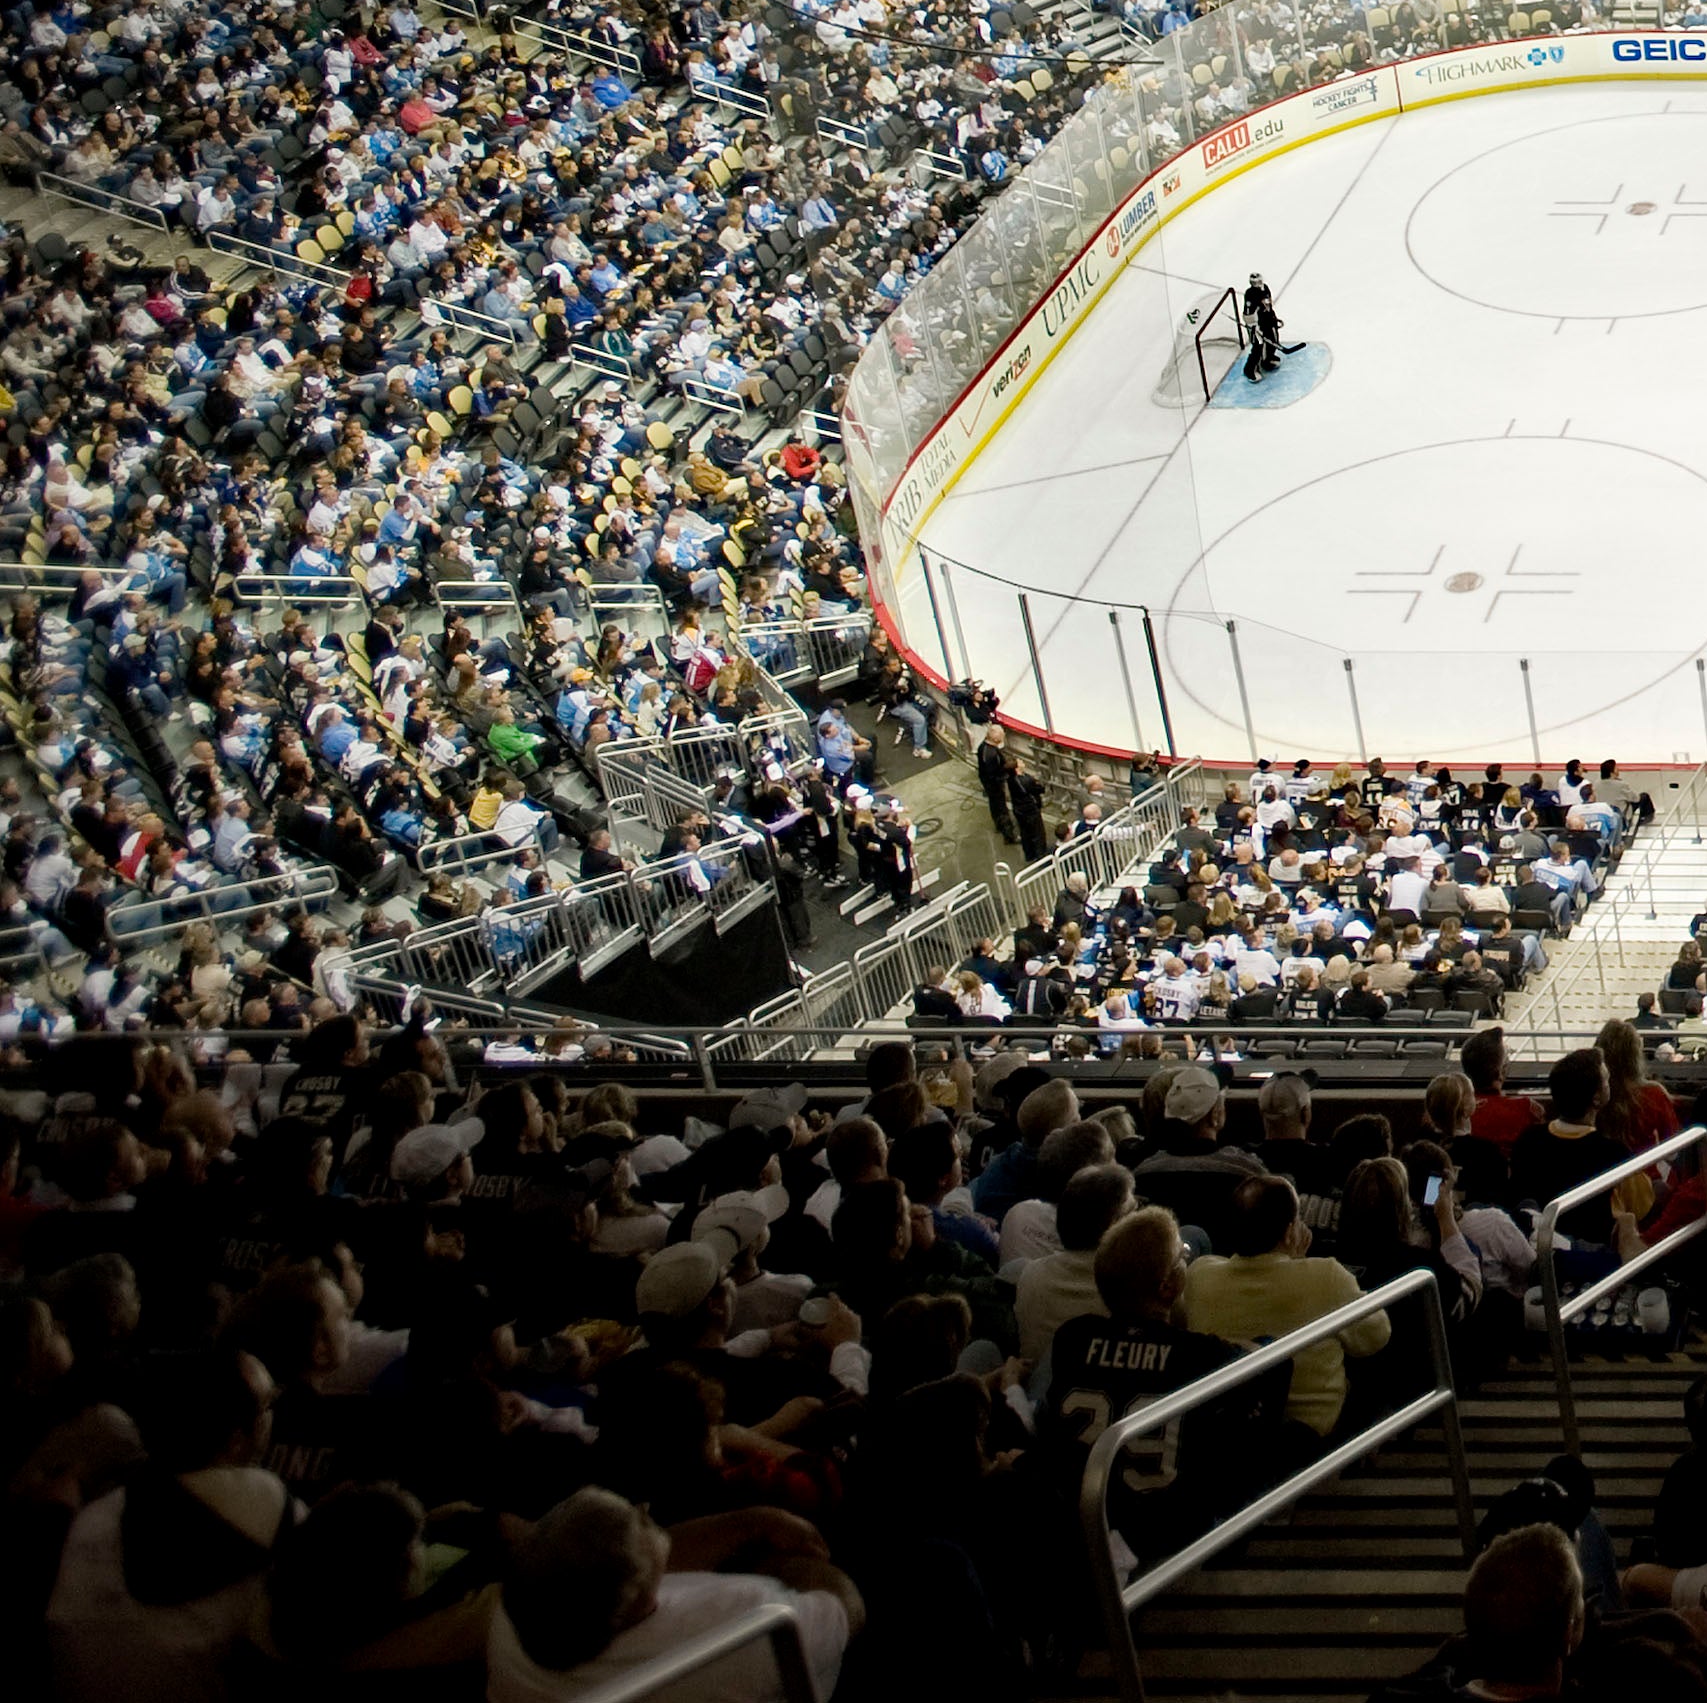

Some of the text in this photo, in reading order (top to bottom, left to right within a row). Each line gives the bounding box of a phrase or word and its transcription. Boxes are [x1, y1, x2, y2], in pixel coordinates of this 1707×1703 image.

[1425, 54, 1527, 86] HIGHMARK
[1326, 96, 1358, 113] CANCER
[1203, 126, 1250, 168] CALU
[1119, 189, 1157, 241] LUMBER
[1039, 250, 1102, 339] UPMC
[991, 343, 1033, 399] verizon
[1154, 987, 1183, 999] CROSBY
[1154, 998, 1179, 1018] 87
[1085, 1337, 1174, 1374] FLEURY
